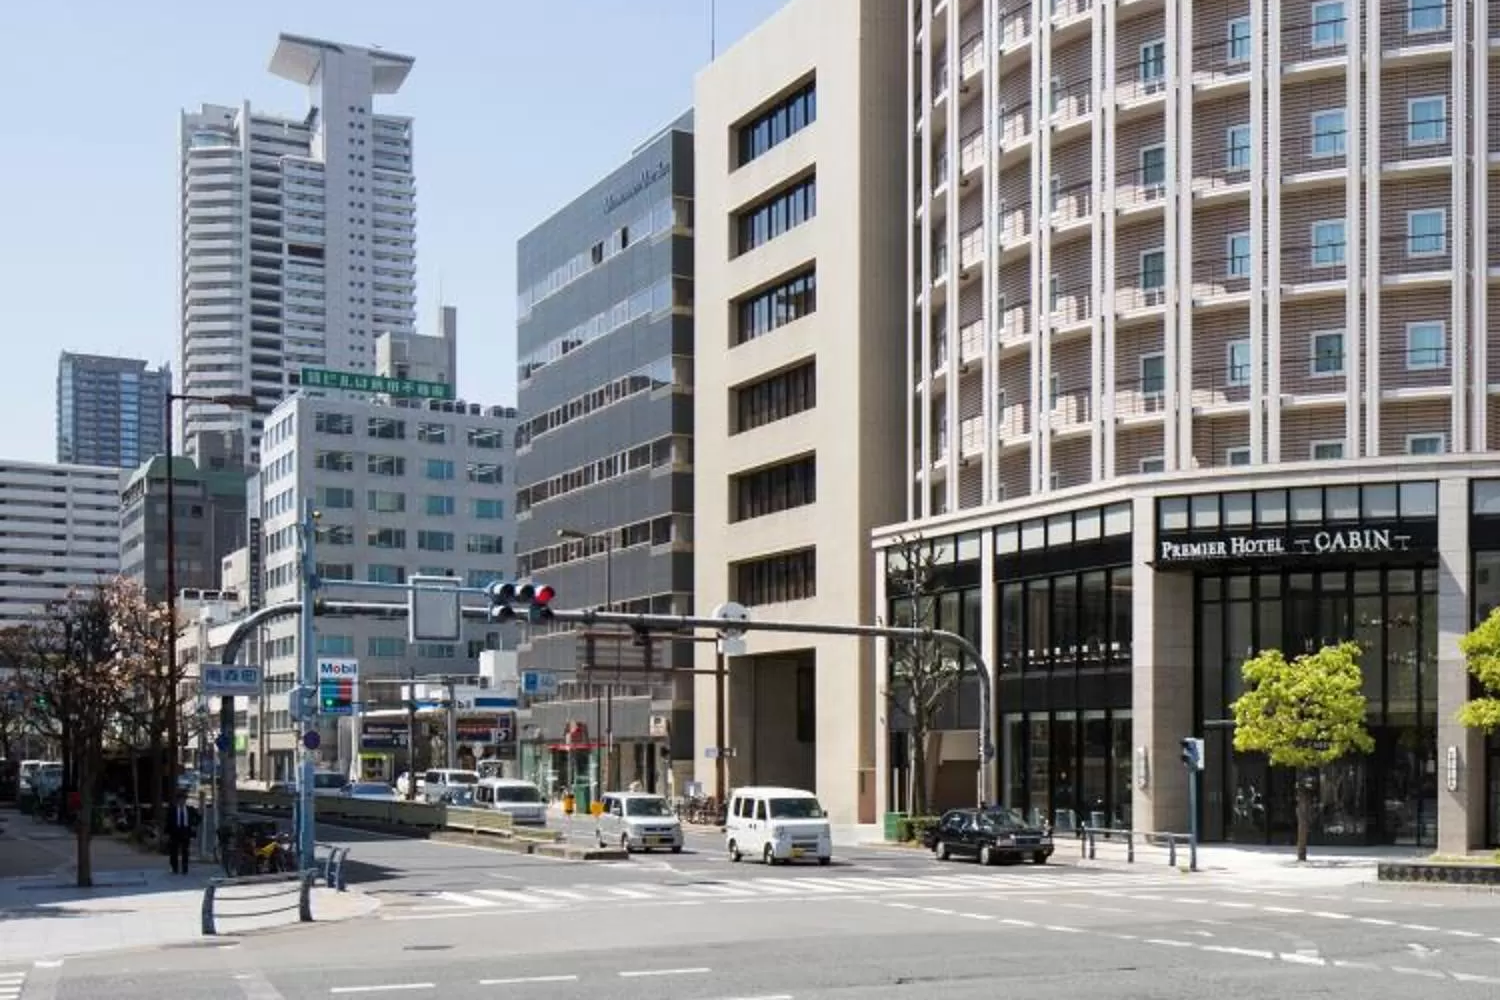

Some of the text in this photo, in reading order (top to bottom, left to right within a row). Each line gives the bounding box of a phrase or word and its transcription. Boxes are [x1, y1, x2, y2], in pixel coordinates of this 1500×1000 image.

[1161, 540, 1228, 560] PREMIER
[1230, 536, 1286, 555] HOTEL
[321, 663, 357, 675] Mobil
